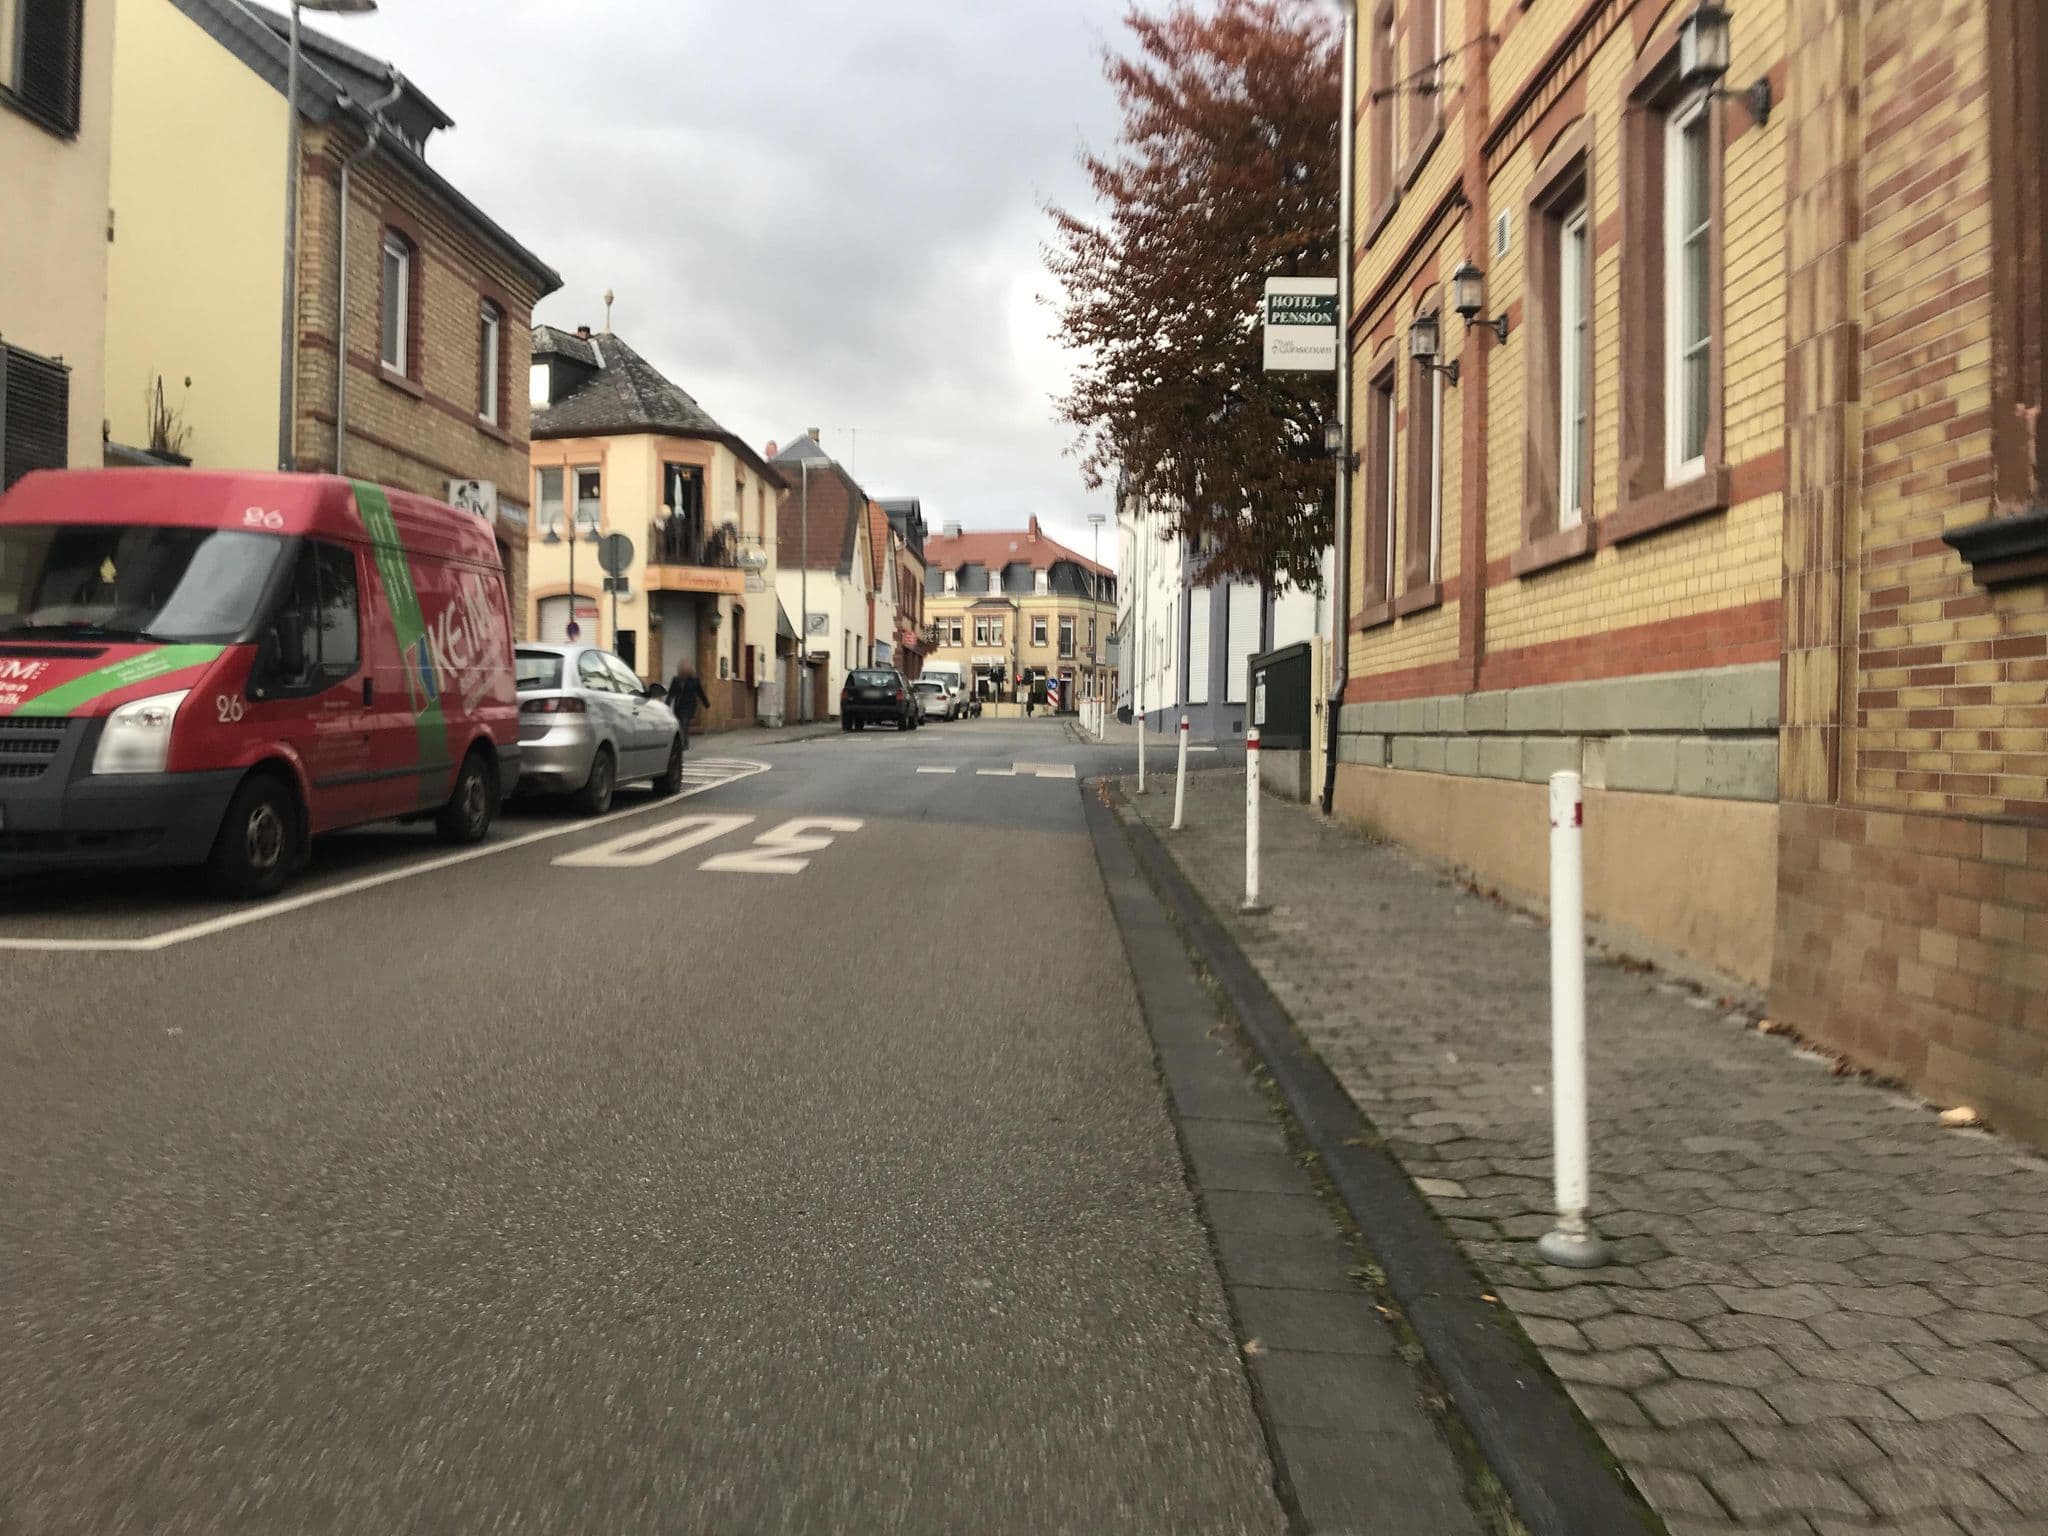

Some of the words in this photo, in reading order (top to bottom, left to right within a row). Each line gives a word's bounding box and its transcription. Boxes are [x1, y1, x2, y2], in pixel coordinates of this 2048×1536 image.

[1271, 295, 1321, 309] HOTEL
[1271, 311, 1333, 324] PENSION
[216, 694, 244, 722] 26
